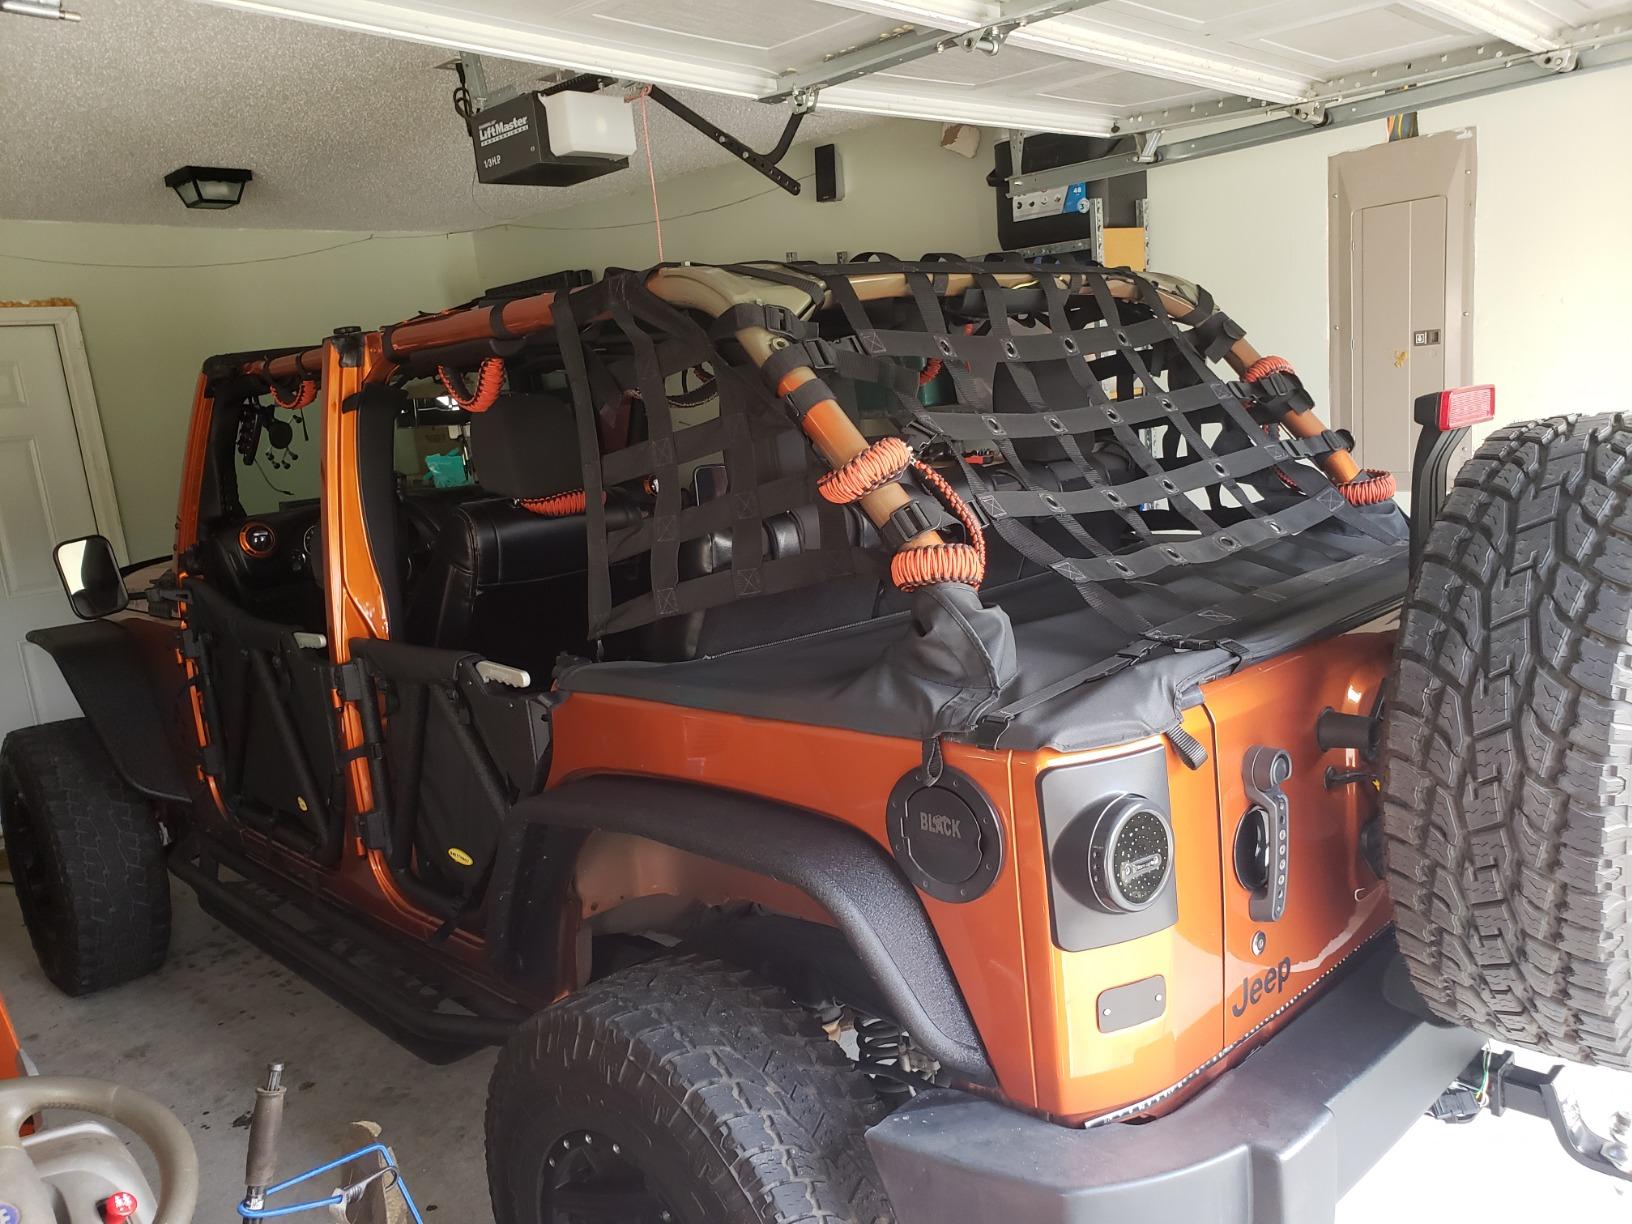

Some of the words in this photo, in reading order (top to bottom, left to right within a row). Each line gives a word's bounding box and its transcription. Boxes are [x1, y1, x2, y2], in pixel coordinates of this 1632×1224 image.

[479, 116, 528, 142] LiftMaster
[920, 811, 961, 839] BLACK
[1231, 956, 1291, 1018] Jeep
